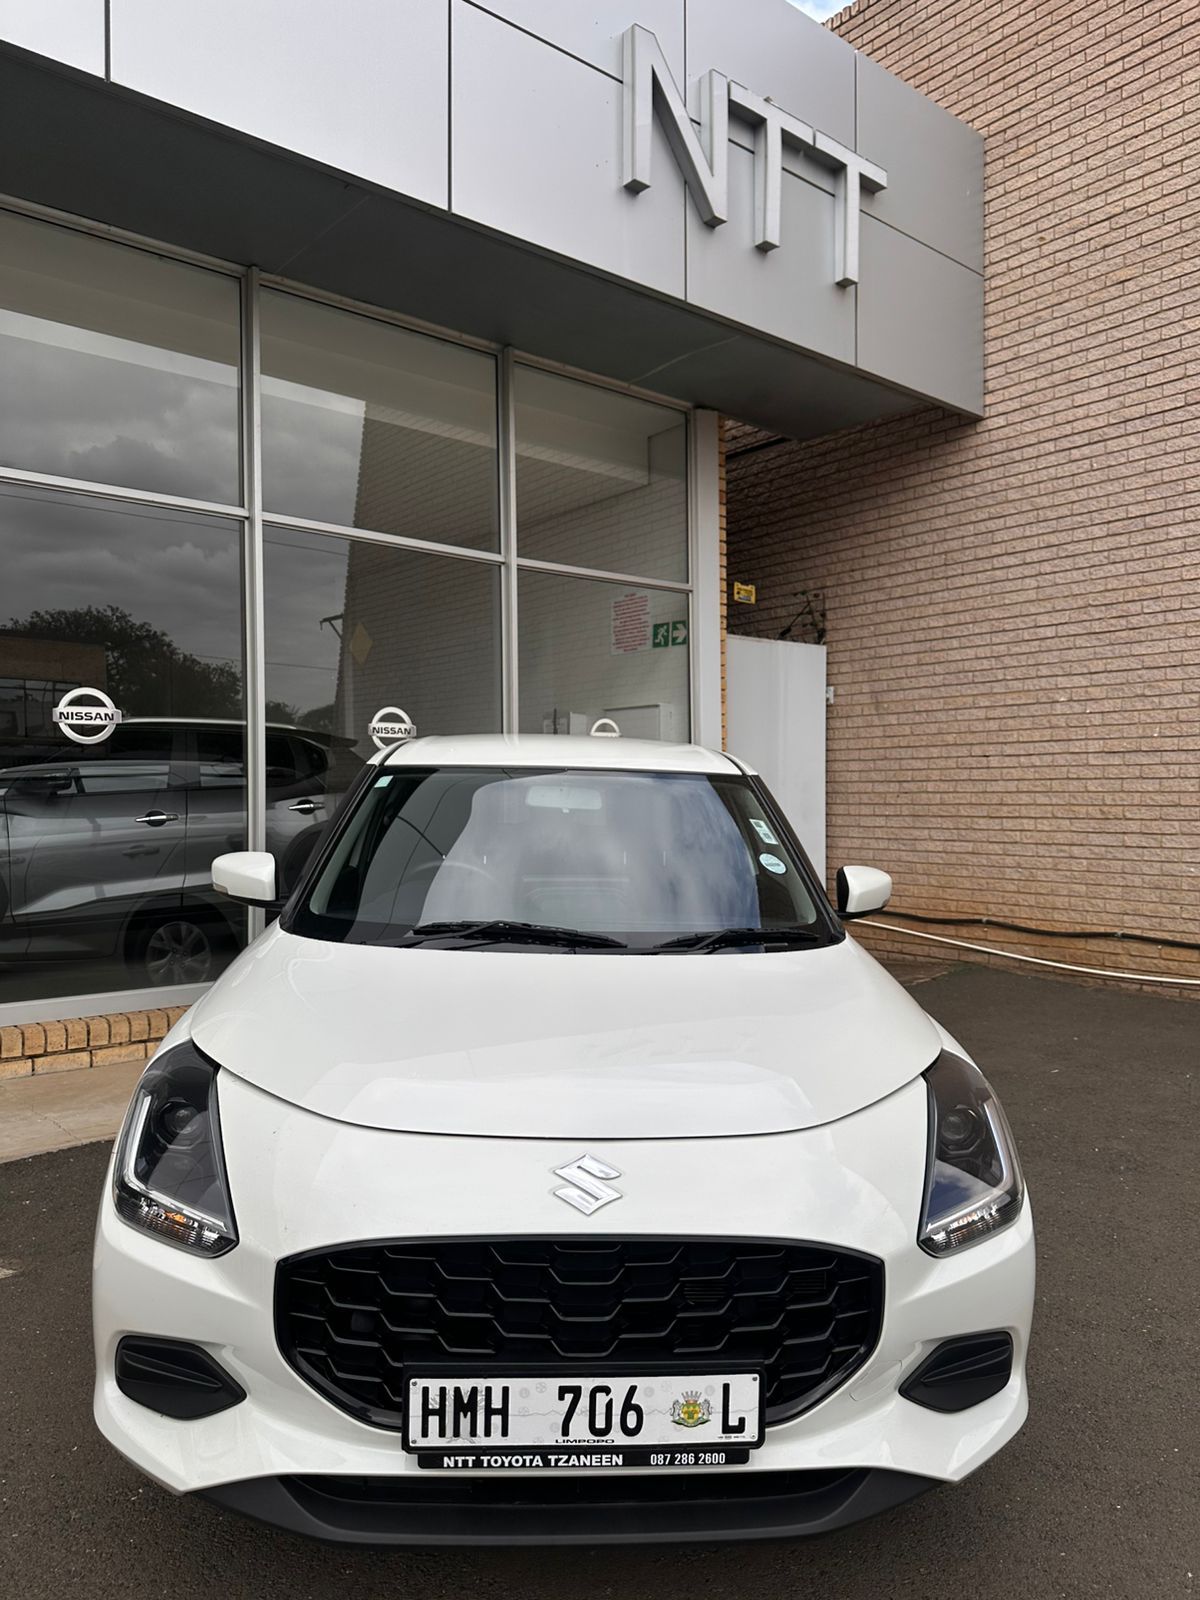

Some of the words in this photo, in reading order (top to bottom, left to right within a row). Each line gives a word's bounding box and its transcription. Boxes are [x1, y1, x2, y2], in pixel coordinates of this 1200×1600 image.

[622, 23, 888, 286] NTT
[58, 711, 114, 722] NISSAN
[372, 726, 411, 736] NISSAN
[421, 1385, 510, 1438] HMH
[557, 1384, 644, 1438] 706
[722, 1382, 746, 1435] L
[443, 1455, 476, 1468] NTT
[480, 1454, 542, 1468] TOYOTA
[548, 1454, 624, 1467] TZANEEN
[650, 1453, 671, 1466] 087
[674, 1453, 696, 1465] 286
[698, 1452, 726, 1465] 2600
